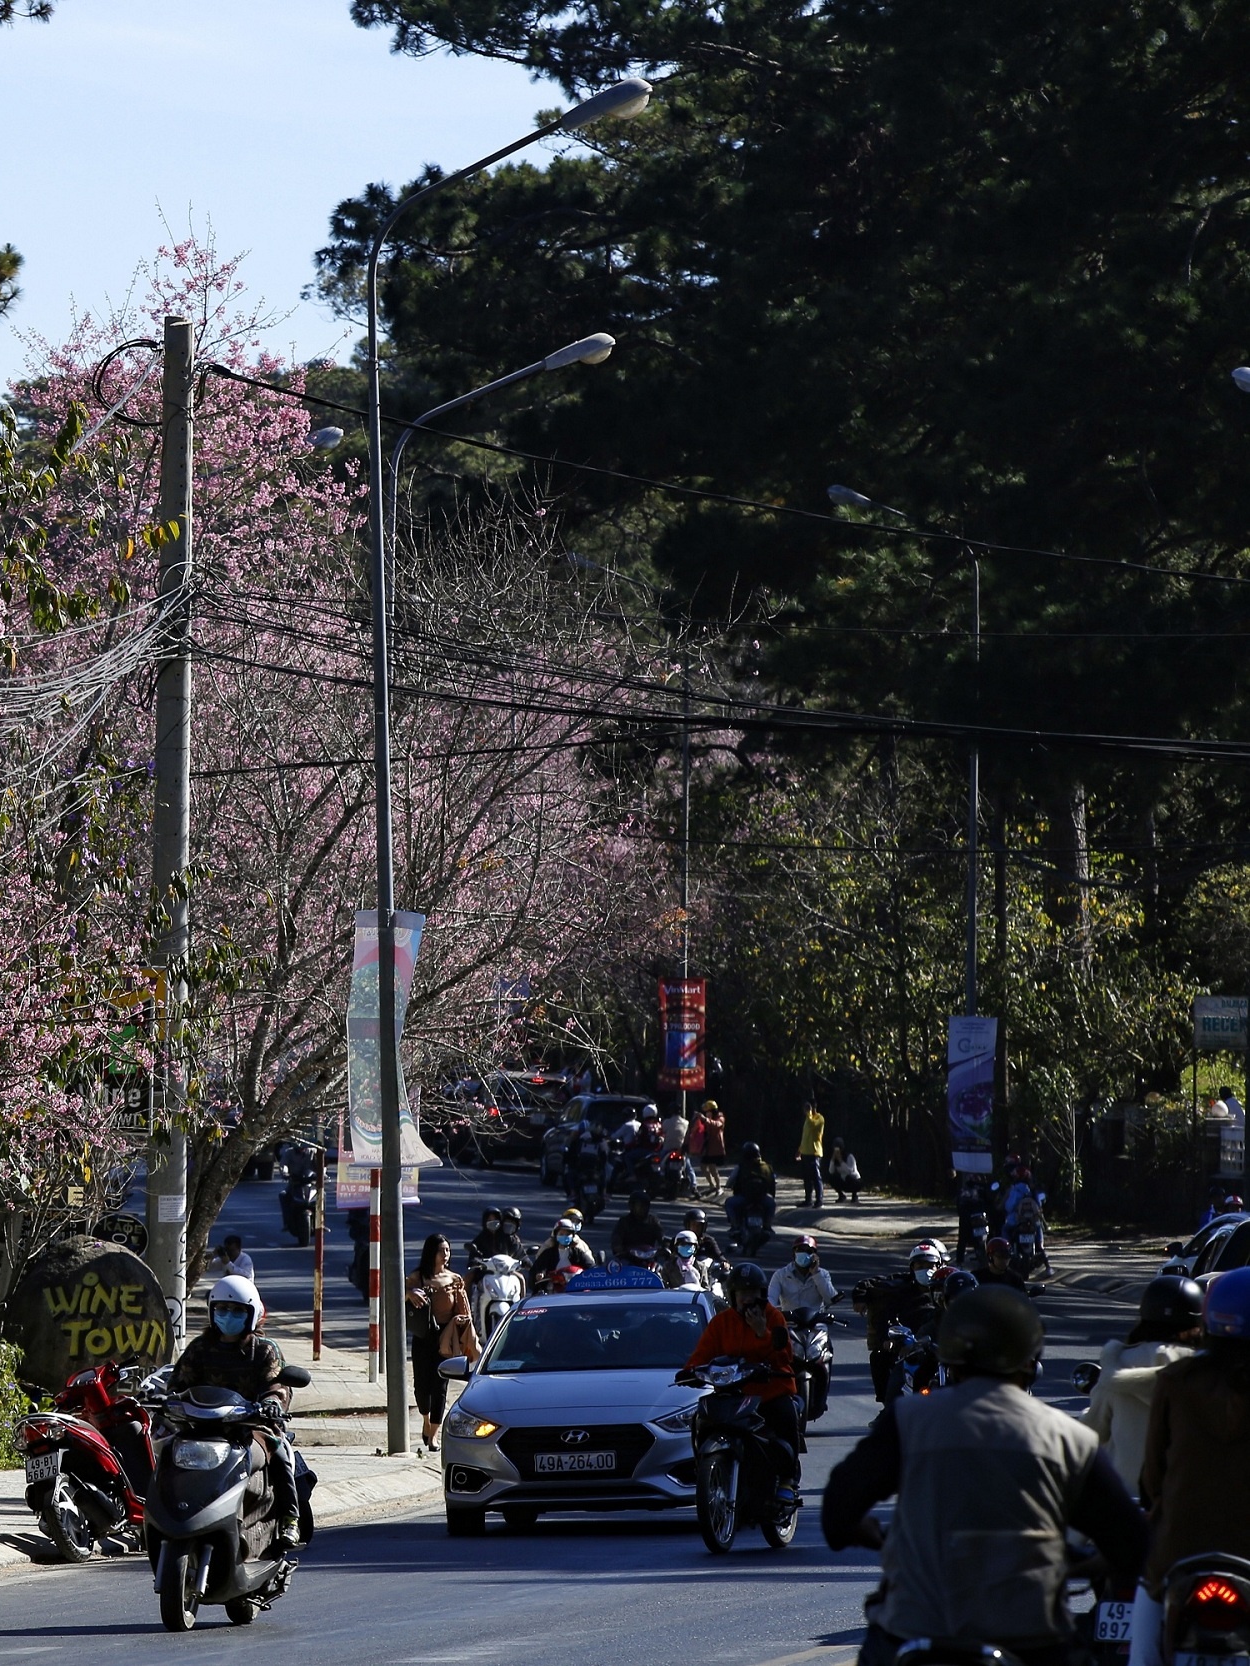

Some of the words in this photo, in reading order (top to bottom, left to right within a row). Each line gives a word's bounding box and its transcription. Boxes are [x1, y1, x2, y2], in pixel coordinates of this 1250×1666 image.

[632, 1276, 654, 1287] 777
[61, 1319, 167, 1357] TOWN
[538, 1453, 614, 1471] 49A-264.00
[28, 1465, 58, 1482] 568.76
